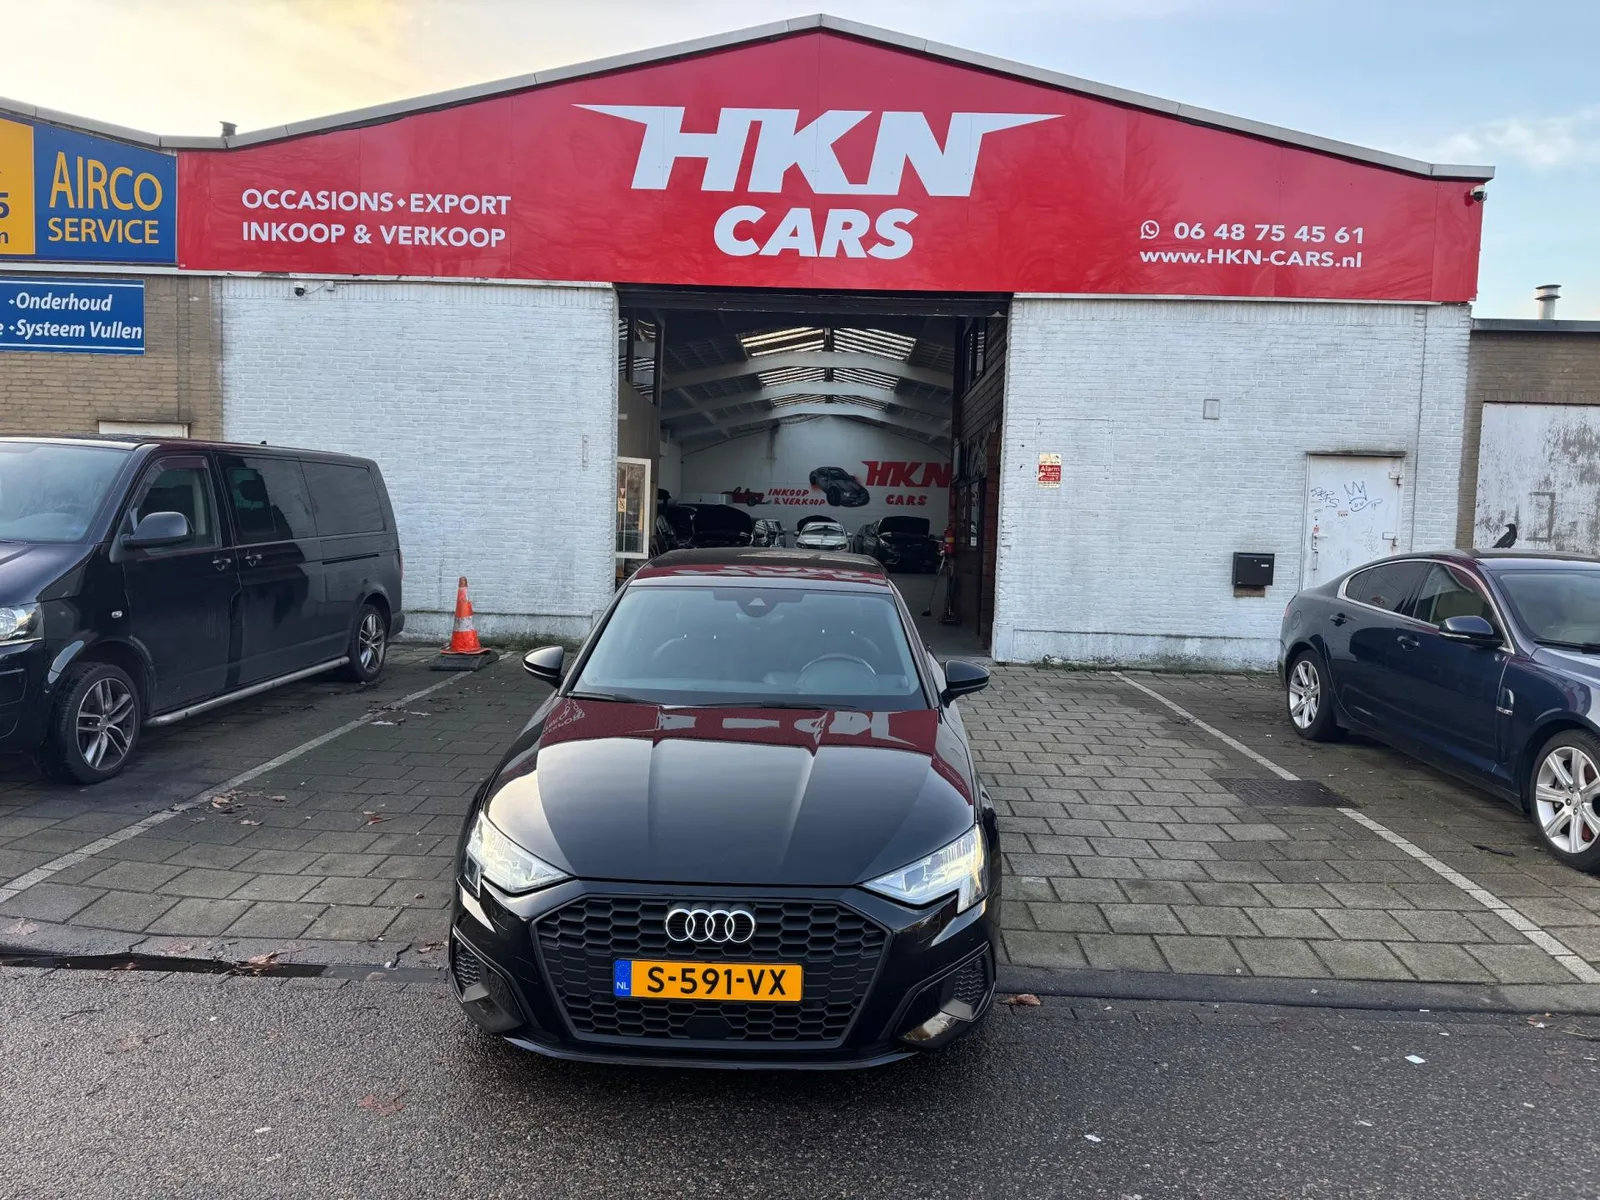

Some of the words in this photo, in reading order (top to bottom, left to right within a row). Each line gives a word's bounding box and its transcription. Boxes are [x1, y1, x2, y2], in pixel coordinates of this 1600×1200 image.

[571, 103, 1066, 198] HKN
[49, 151, 163, 212] AIRCO
[47, 217, 160, 244] SERVICE
[242, 221, 346, 244] INKOOP
[353, 224, 372, 245] &
[379, 225, 506, 248] VERKOOP
[713, 205, 919, 260] CARS
[1173, 222, 1206, 240] 06
[1213, 223, 1246, 241] 48
[1254, 224, 1286, 242] 75
[1293, 225, 1326, 243] 45
[1334, 227, 1364, 244] 61
[1139, 248, 1363, 268] www.HKN-CARS.nl
[16, 292, 113, 312] Onderhoud
[15, 318, 85, 341] Systeem
[90, 320, 142, 340] Vullen
[861, 460, 951, 488] HKN
[767, 488, 810, 497] INKOOP
[773, 497, 782, 506] &
[782, 497, 827, 506] VERKOOP
[885, 494, 928, 506] CARS
[616, 981, 630, 991] NL
[647, 966, 787, 996] S-591-VX
